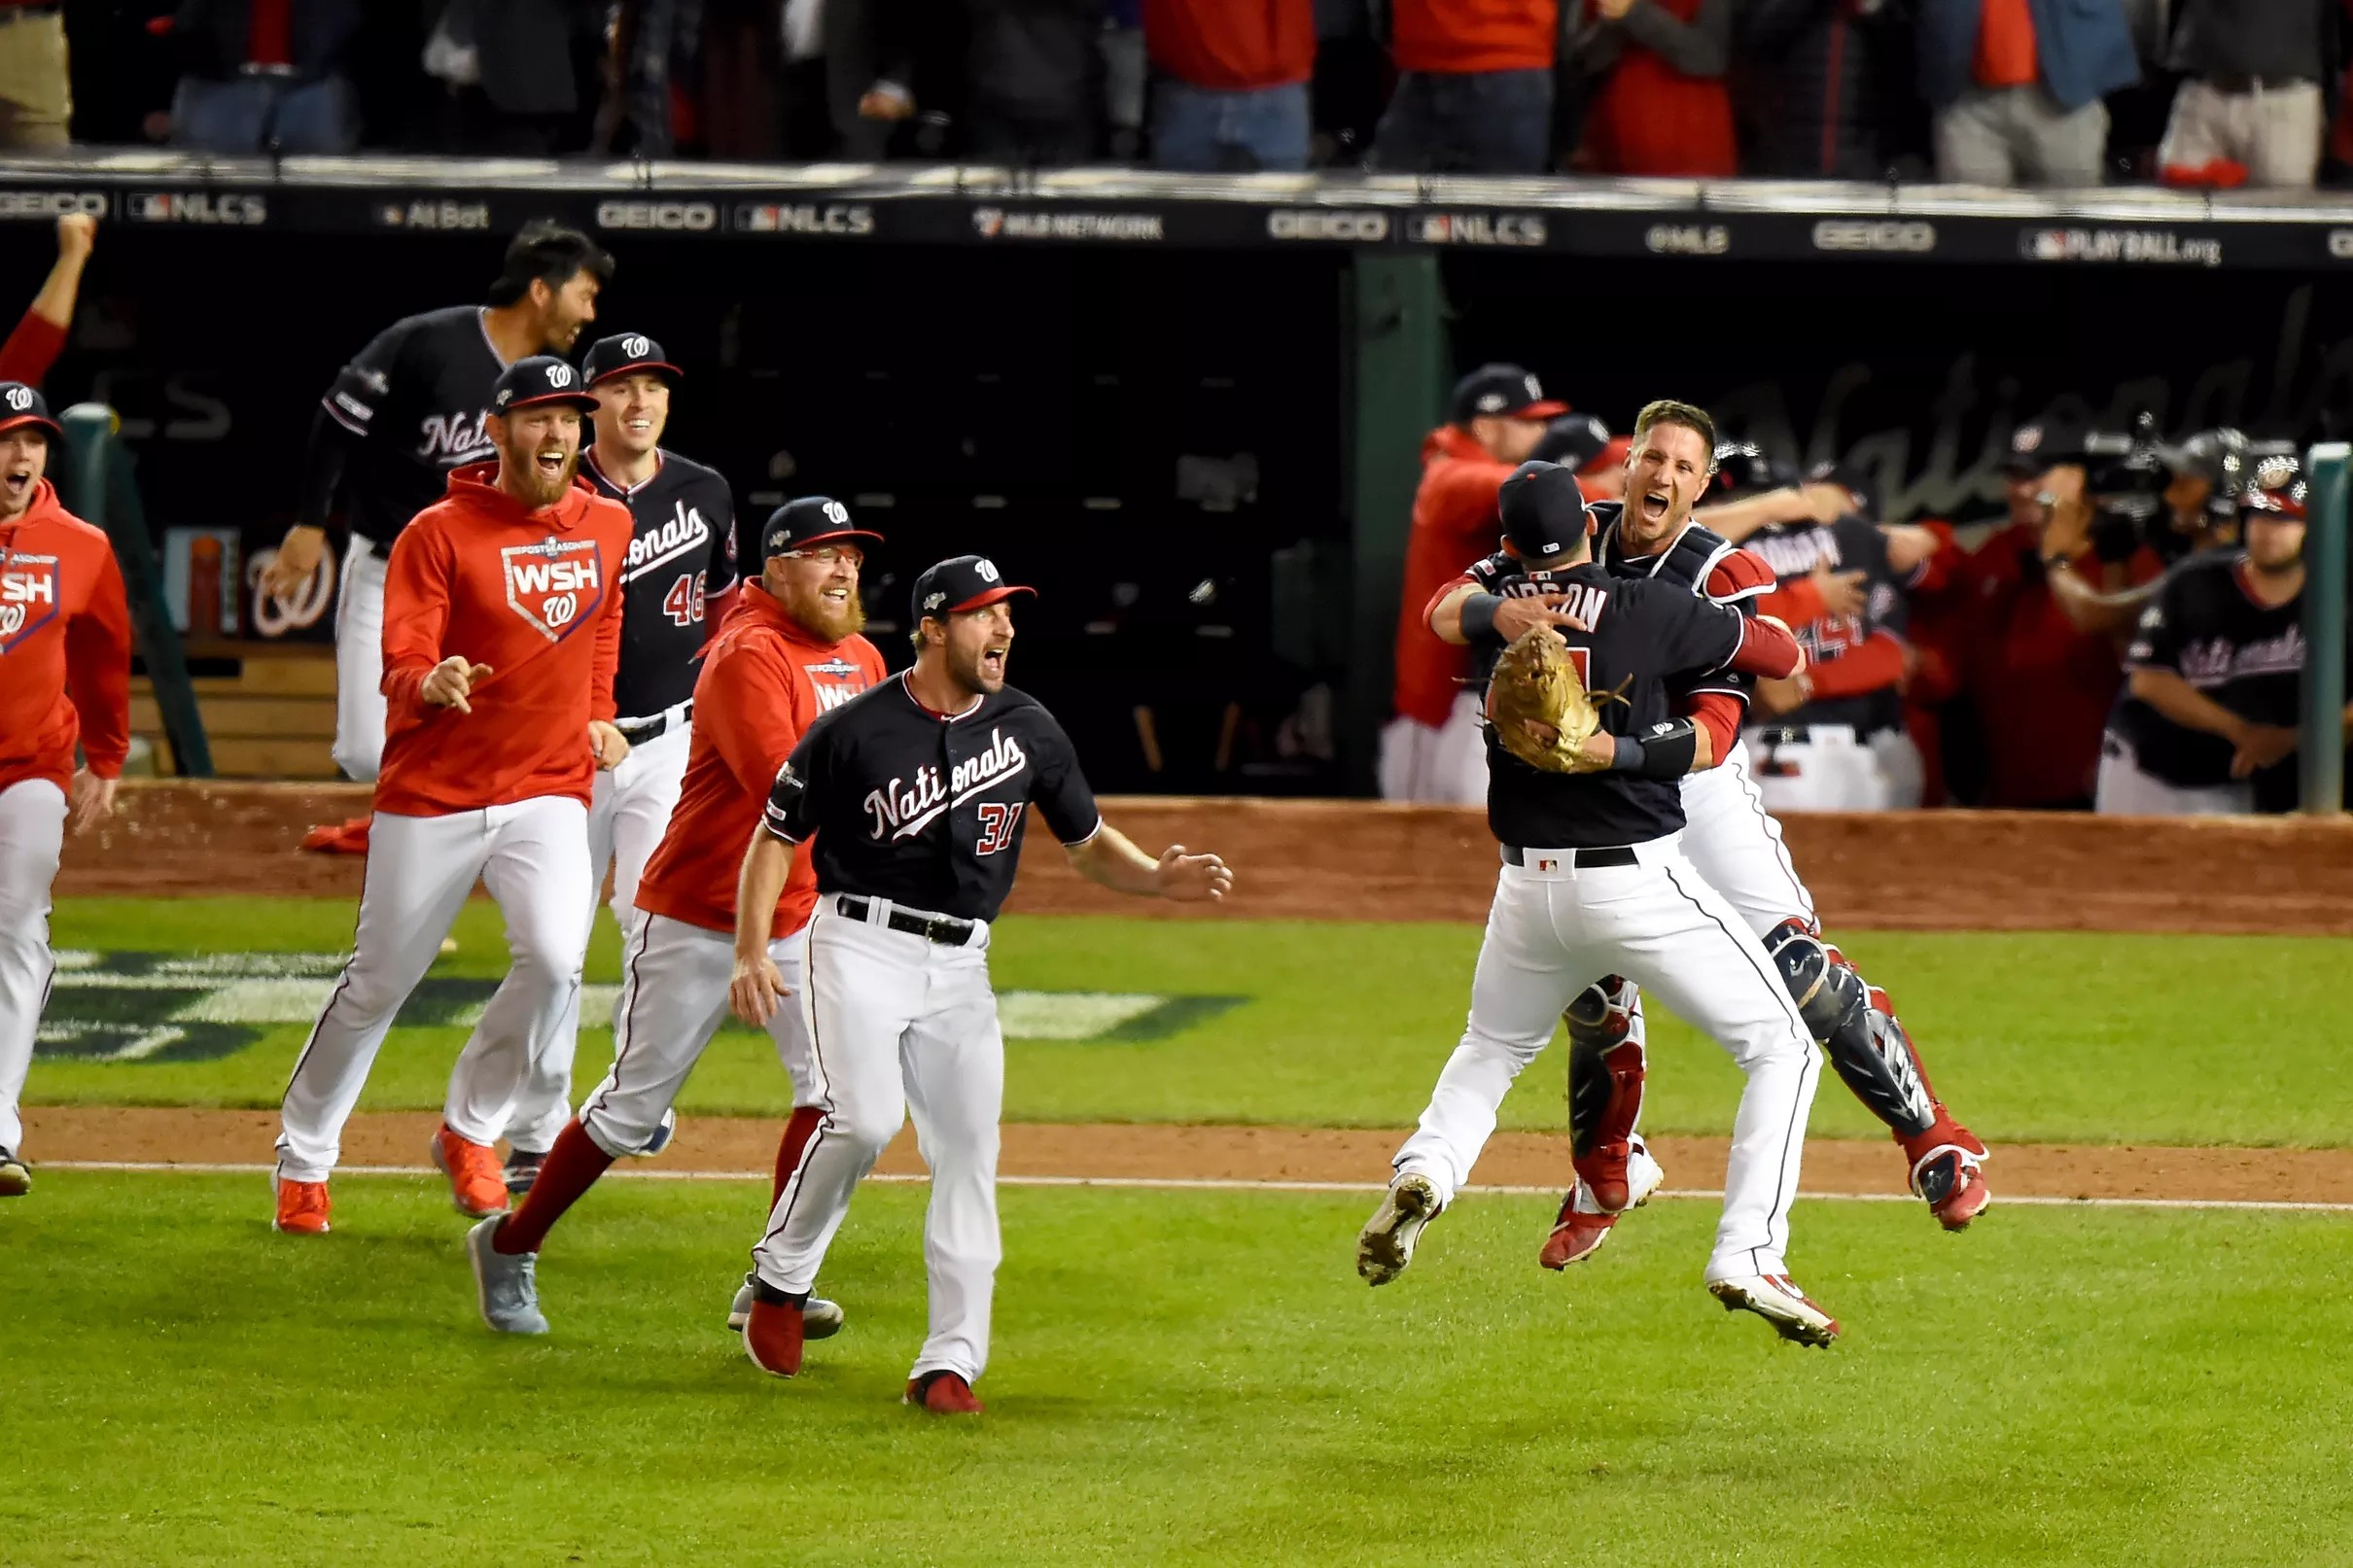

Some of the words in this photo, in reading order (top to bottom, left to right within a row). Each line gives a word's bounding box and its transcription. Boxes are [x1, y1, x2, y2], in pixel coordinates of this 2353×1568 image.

[171, 193, 266, 225] NLCS
[597, 201, 717, 229] GEICO
[777, 204, 873, 233] NLCS
[1268, 210, 1388, 241] GEICO
[1449, 214, 1546, 247] NLCS
[1812, 220, 1935, 251] GEICO
[512, 557, 599, 594] WSH
[863, 725, 1026, 842] Nationals
[975, 802, 1025, 857] 31
